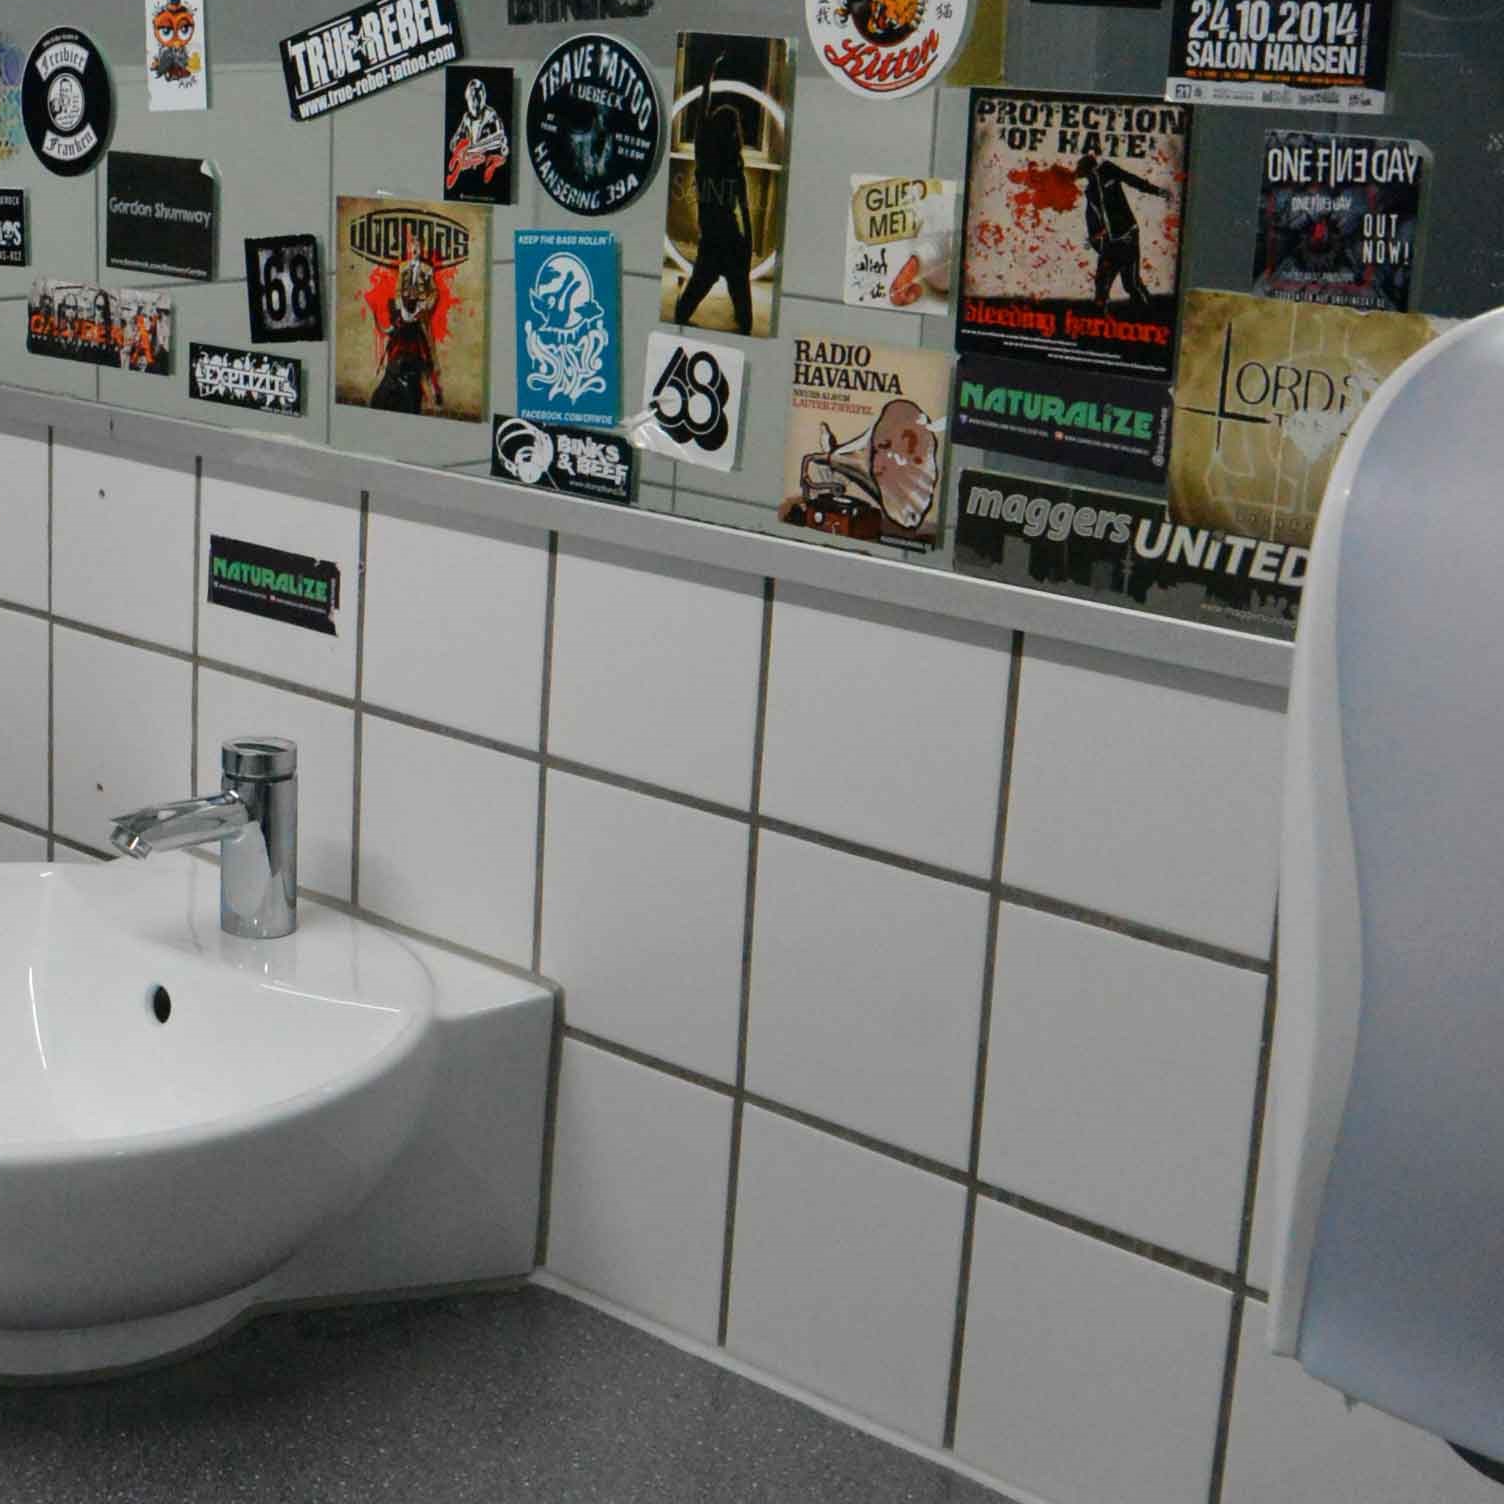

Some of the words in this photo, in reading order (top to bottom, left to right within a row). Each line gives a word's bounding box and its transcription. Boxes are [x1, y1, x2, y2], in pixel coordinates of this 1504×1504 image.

[287, 19, 362, 95] TRUE
[824, 28, 940, 92] Kitten
[1185, 39, 1258, 72] SALON
[1263, 45, 1358, 76] HANSEN
[297, 42, 457, 120] www.true-rebel-tattoo.com
[539, 43, 595, 102] TRAVE
[599, 43, 653, 132] TATTOO
[976, 96, 1189, 136] PROTECTION
[45, 128, 95, 158] Franken
[534, 139, 602, 210] HANSERING
[605, 172, 639, 206] 39A
[1267, 147, 1313, 184] ONE
[1371, 148, 1424, 185] DAY
[108, 197, 153, 217] Gordon
[154, 202, 212, 228] Shumway
[1363, 213, 1399, 238] OUT
[540, 234, 556, 245] THE
[1362, 241, 1410, 266] NOW!
[260, 251, 316, 325] 68
[794, 339, 872, 368] RADIO
[793, 362, 904, 395] HAVANNA
[556, 433, 621, 464] BINKS
[556, 453, 576, 476] &
[576, 457, 630, 485] BEEF
[965, 484, 1132, 544] maggers
